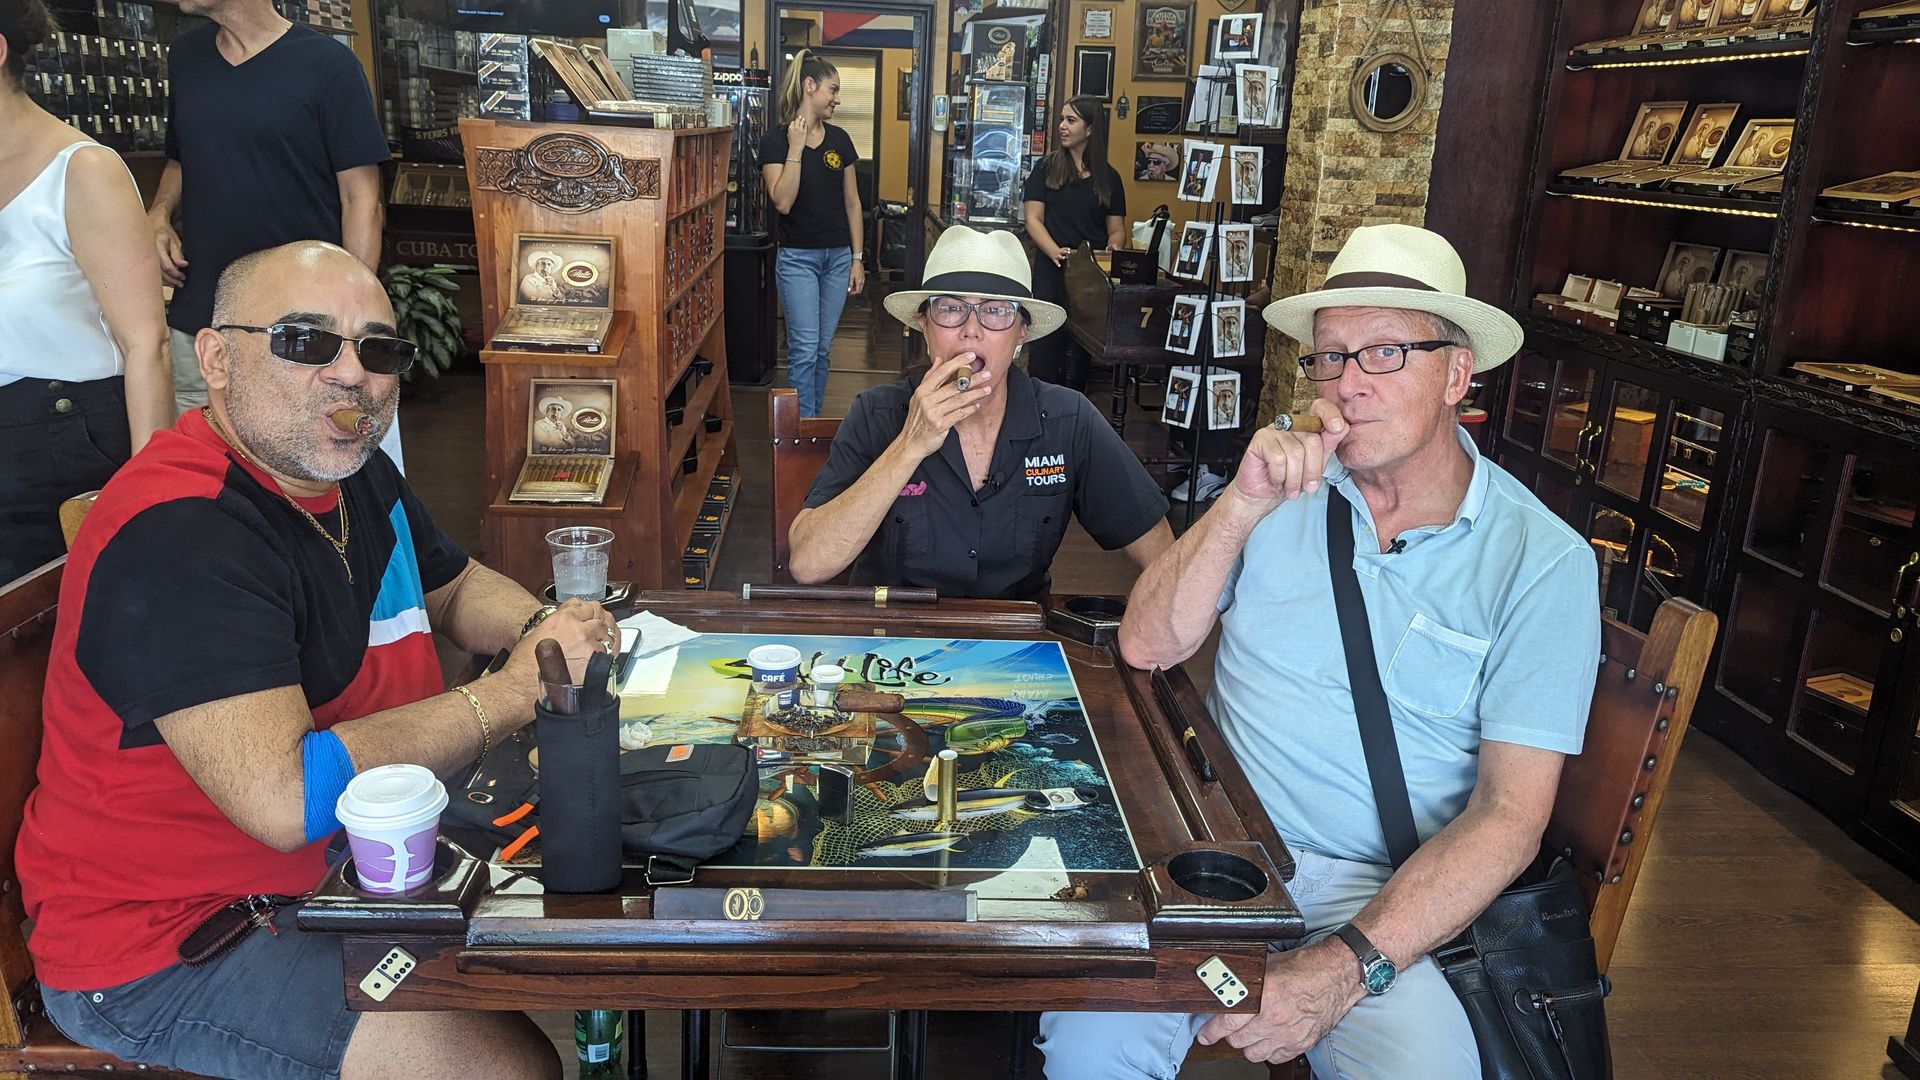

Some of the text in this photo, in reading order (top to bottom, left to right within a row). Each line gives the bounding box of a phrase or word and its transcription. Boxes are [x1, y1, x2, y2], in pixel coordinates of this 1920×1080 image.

[396, 240, 452, 257] CUBA
[1140, 307, 1154, 329] 7
[1025, 454, 1065, 468] MIAMI
[1025, 466, 1065, 476] CULINARY
[1026, 474, 1066, 486] TOURS
[860, 652, 953, 687] Life
[761, 672, 786, 682] CAFÉ
